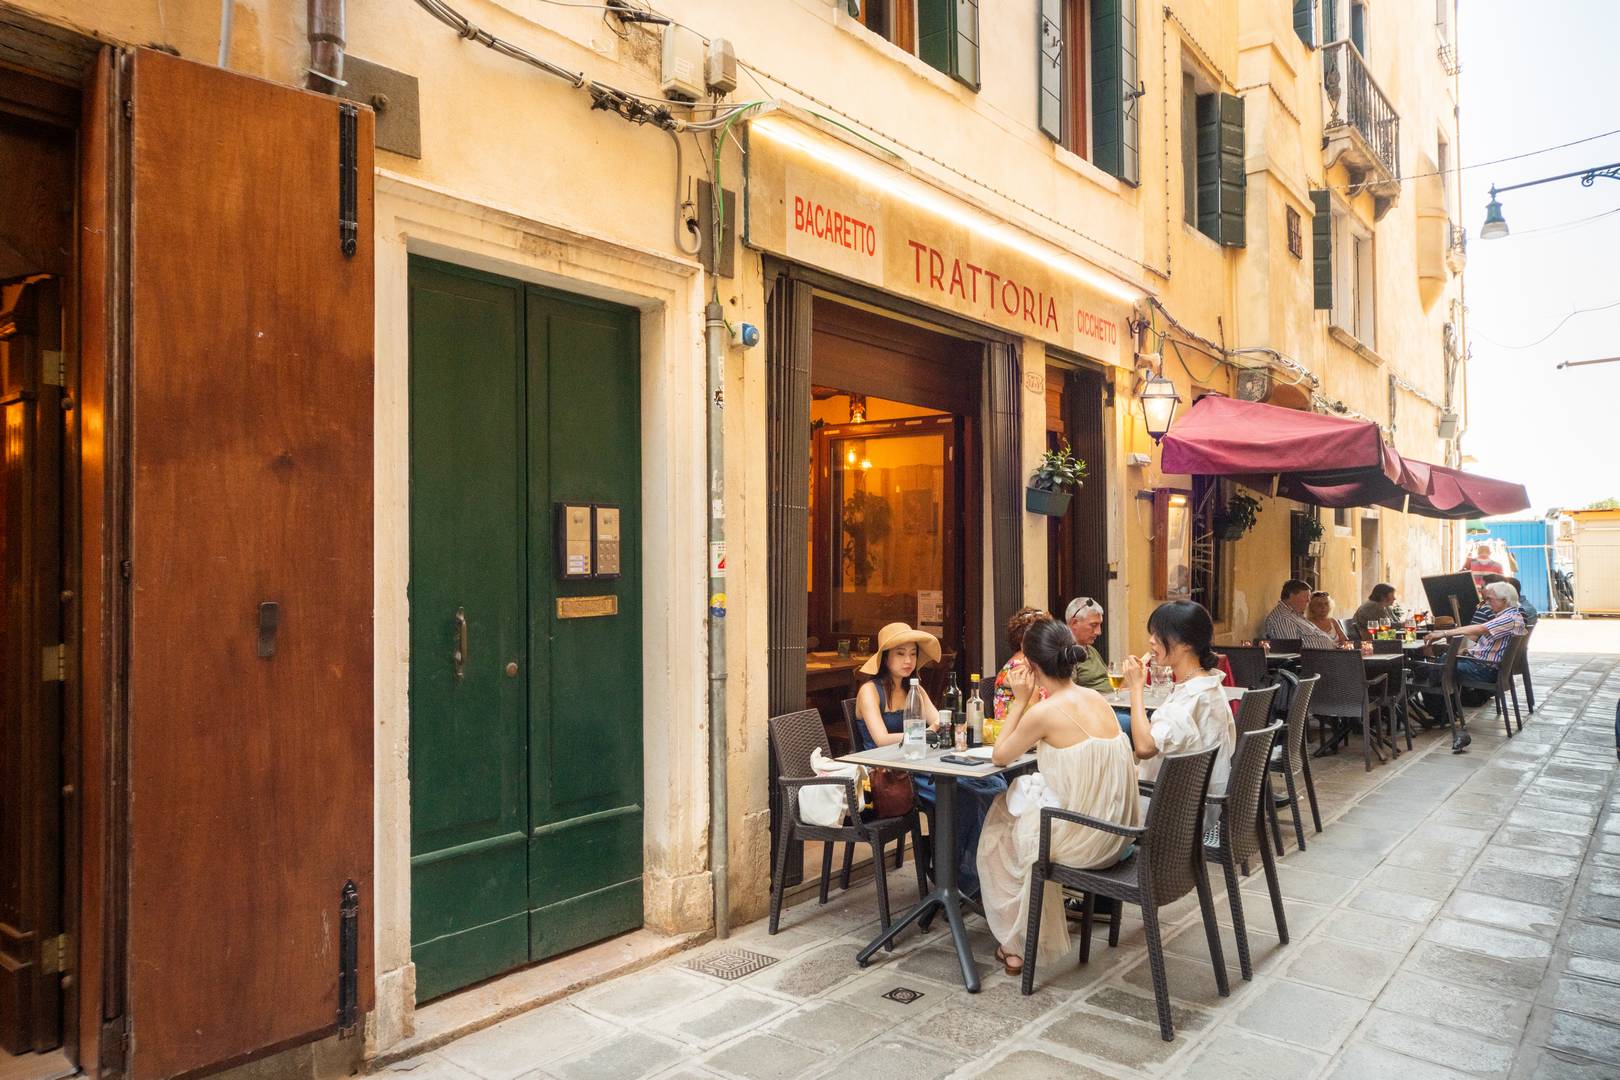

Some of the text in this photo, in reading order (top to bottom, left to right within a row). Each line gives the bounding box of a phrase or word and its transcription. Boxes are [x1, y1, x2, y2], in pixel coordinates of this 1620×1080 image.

[795, 196, 876, 257] BACARETTO
[908, 239, 1059, 333] TRATTORIA
[1077, 309, 1117, 345] CICCHETTO
